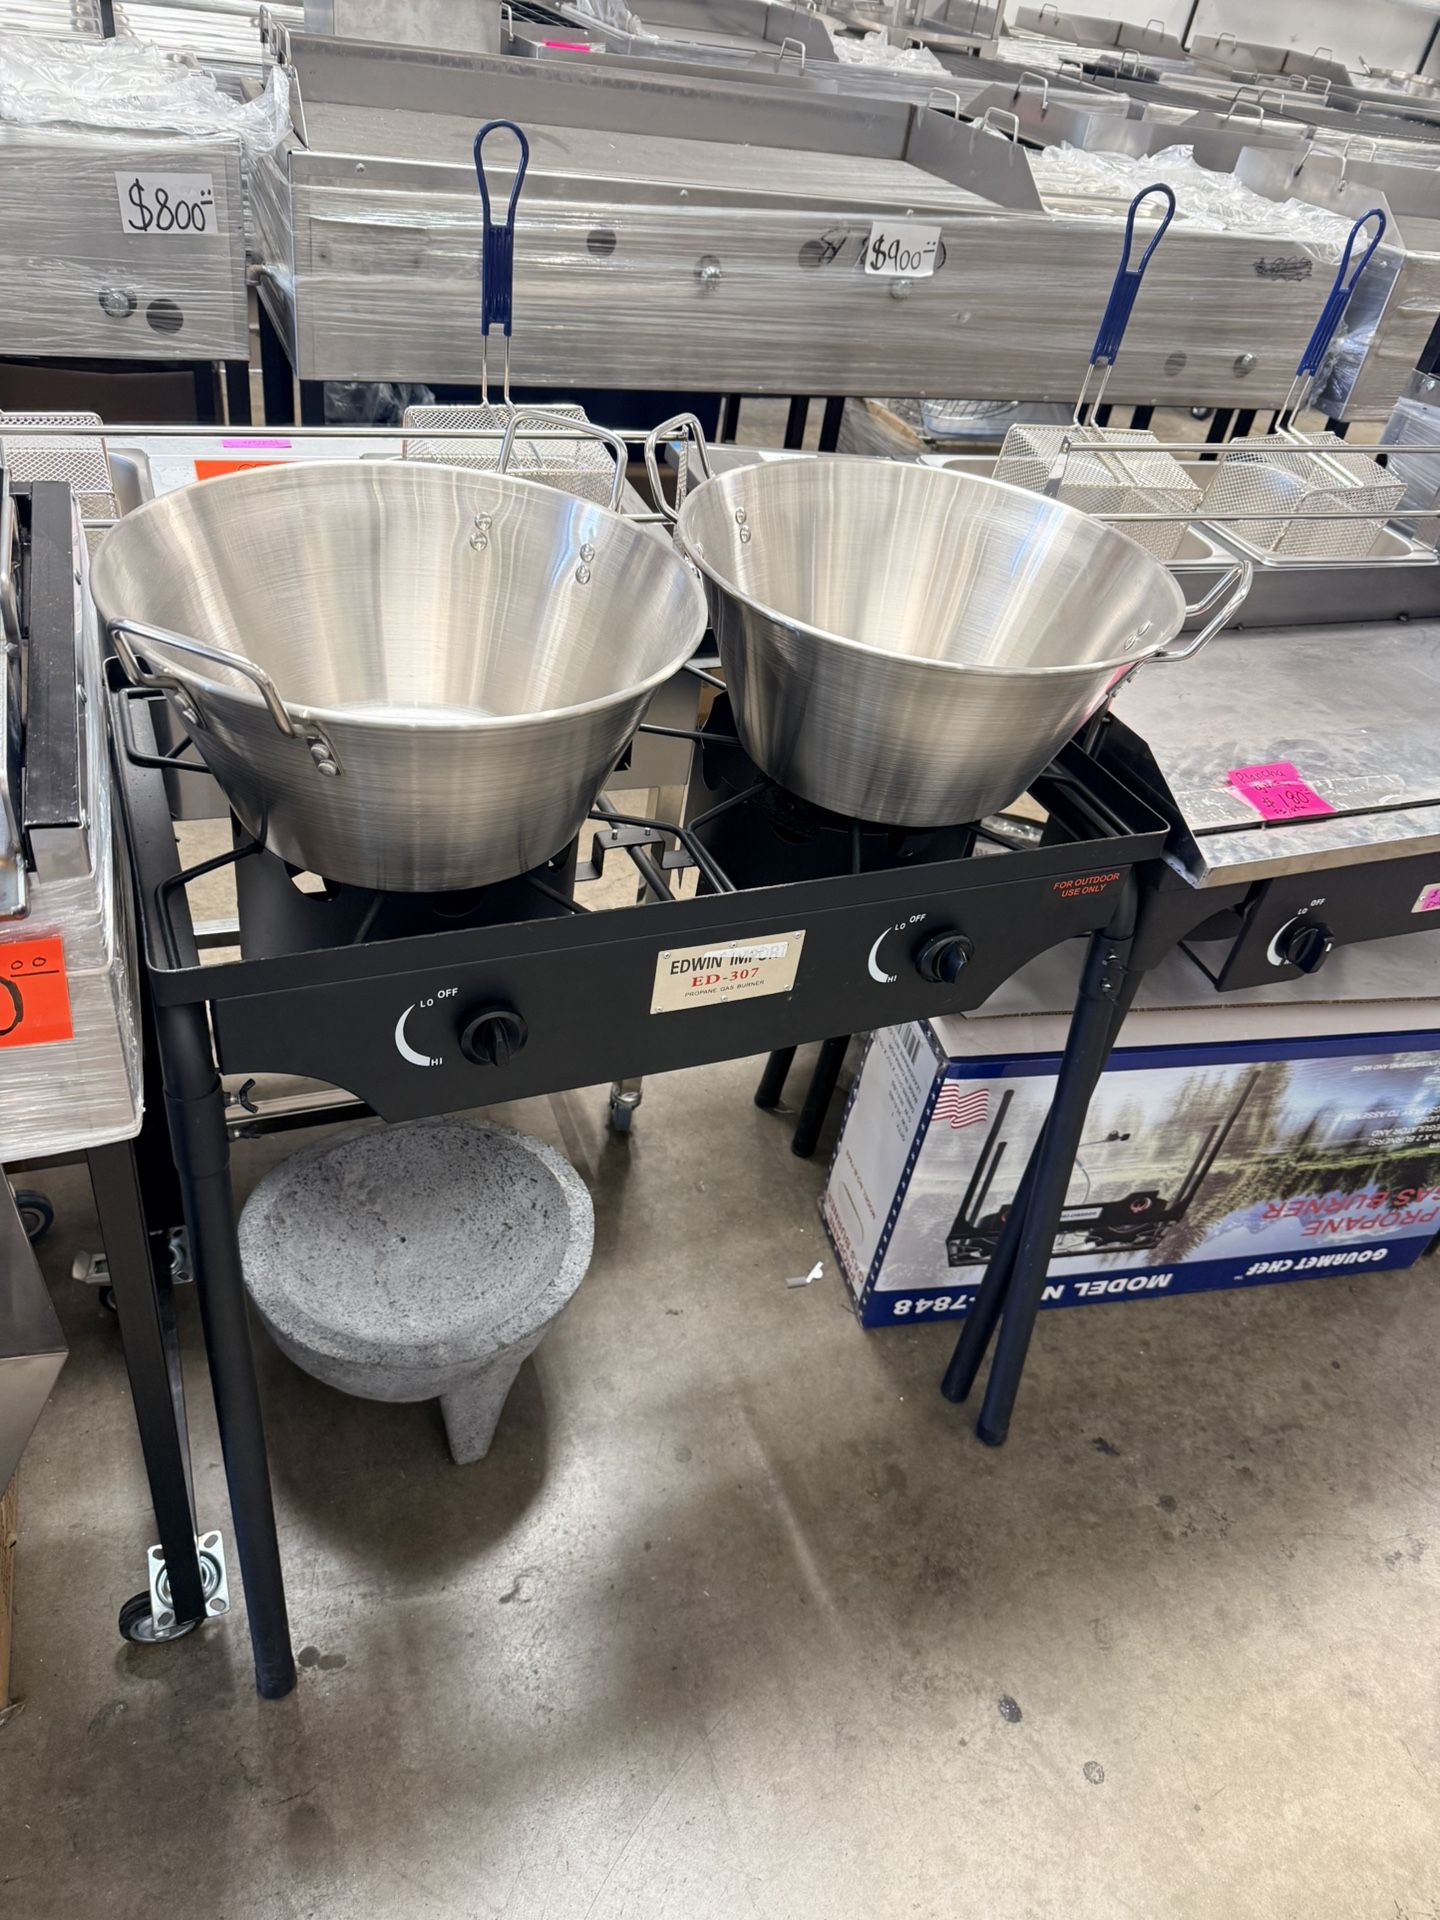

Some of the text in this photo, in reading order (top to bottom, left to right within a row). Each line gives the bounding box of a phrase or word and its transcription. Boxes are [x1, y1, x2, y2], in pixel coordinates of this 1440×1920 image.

[1053, 872, 1120, 890] FOR OUTDOOR
[1061, 884, 1106, 897] USE ONLY
[1297, 897, 1326, 915] LO OFF
[894, 913, 927, 931] LO OFF
[670, 956, 722, 975] EDWIN
[691, 967, 759, 988] ED-307
[887, 974, 897, 983] HI
[420, 987, 459, 1008] LO OFF
[684, 979, 765, 998] PROPANE GAS BURNER
[431, 1057, 443, 1067] HI
[1371, 1123, 1440, 1138] EGULATOR AND
[1262, 1190, 1389, 1221] BURNER
[1301, 1208, 1440, 1237] PROPANE
[1245, 1248, 1388, 1276] GOURMET CHEF
[1074, 1272, 1174, 1297] MODEL
[893, 1294, 977, 1315] -7848
